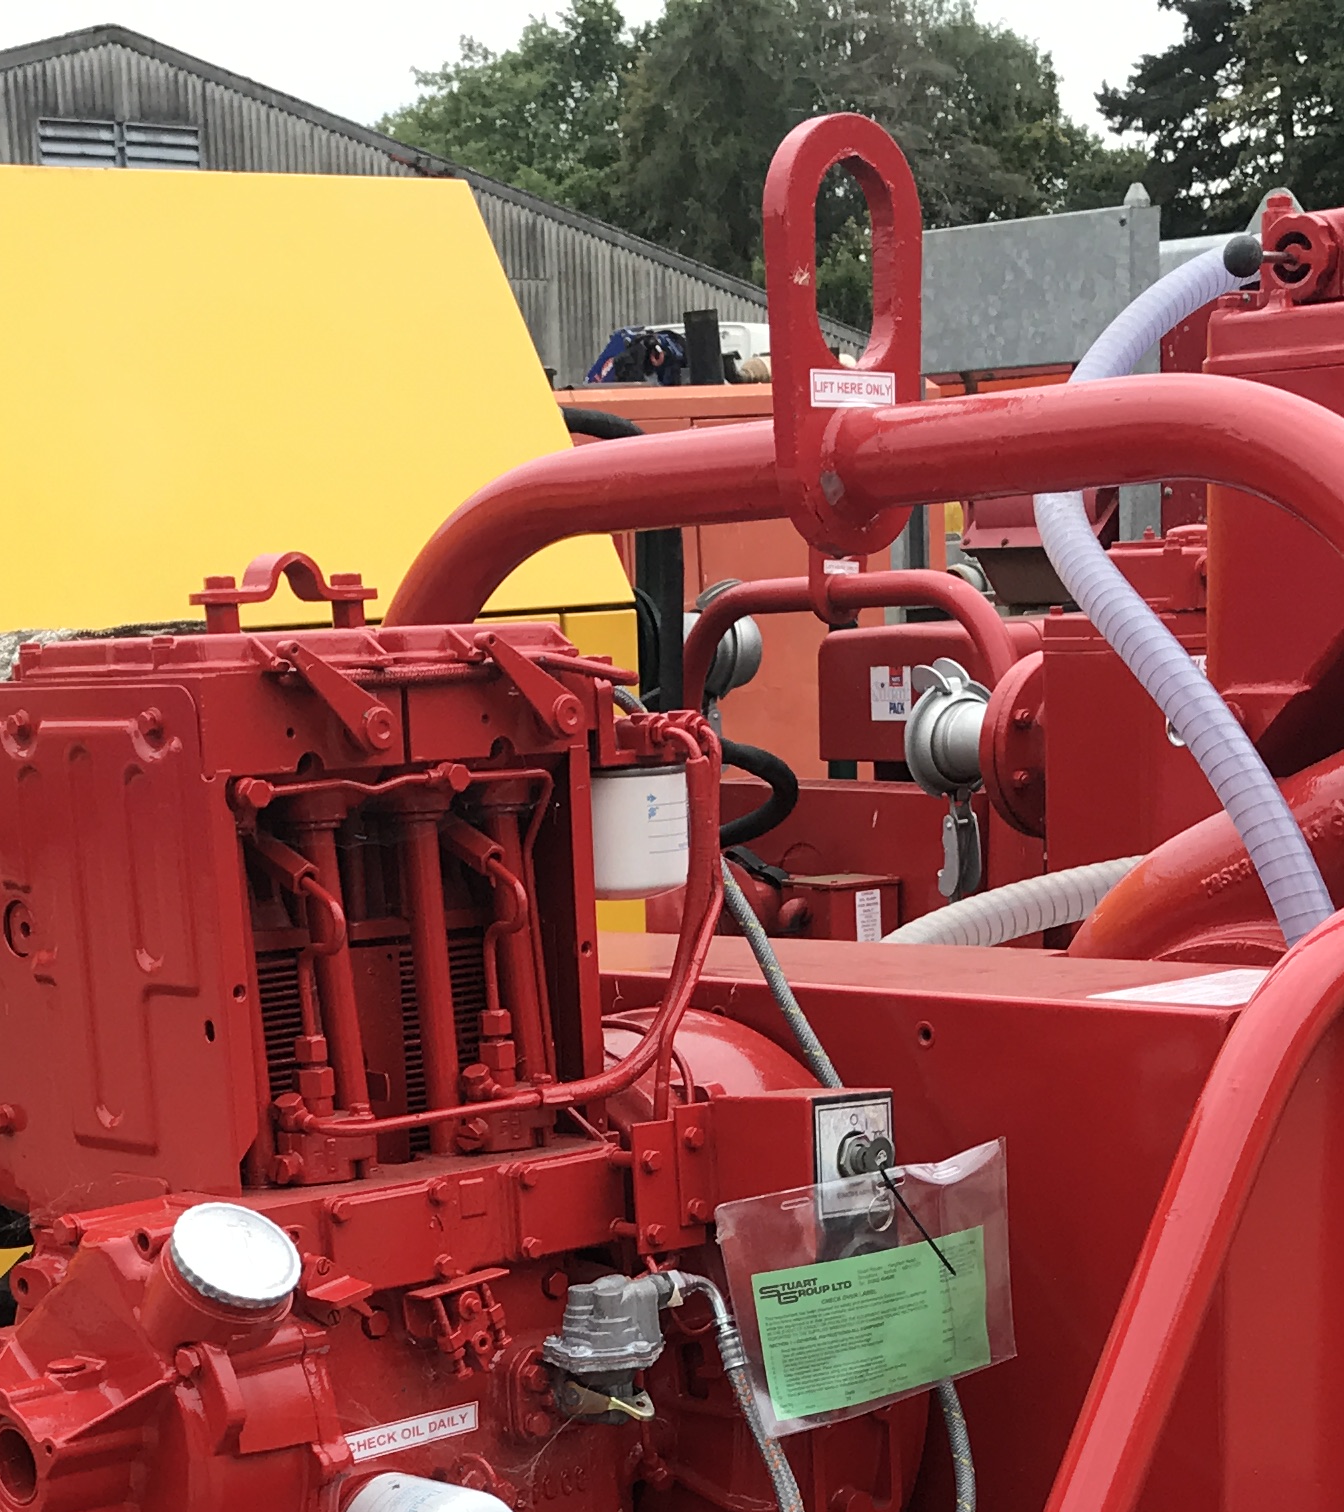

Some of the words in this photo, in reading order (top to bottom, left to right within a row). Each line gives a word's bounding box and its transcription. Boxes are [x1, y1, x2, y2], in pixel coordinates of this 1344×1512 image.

[814, 381, 835, 394] LIFT
[837, 382, 864, 395] HERE
[866, 383, 892, 396] ONLY
[758, 1277, 818, 1300] STUART
[778, 1284, 830, 1306] GROUP
[831, 1280, 853, 1292] LTD
[347, 1431, 397, 1454] CHECK
[401, 1425, 425, 1440] OIL
[428, 1412, 468, 1434] DAILY
